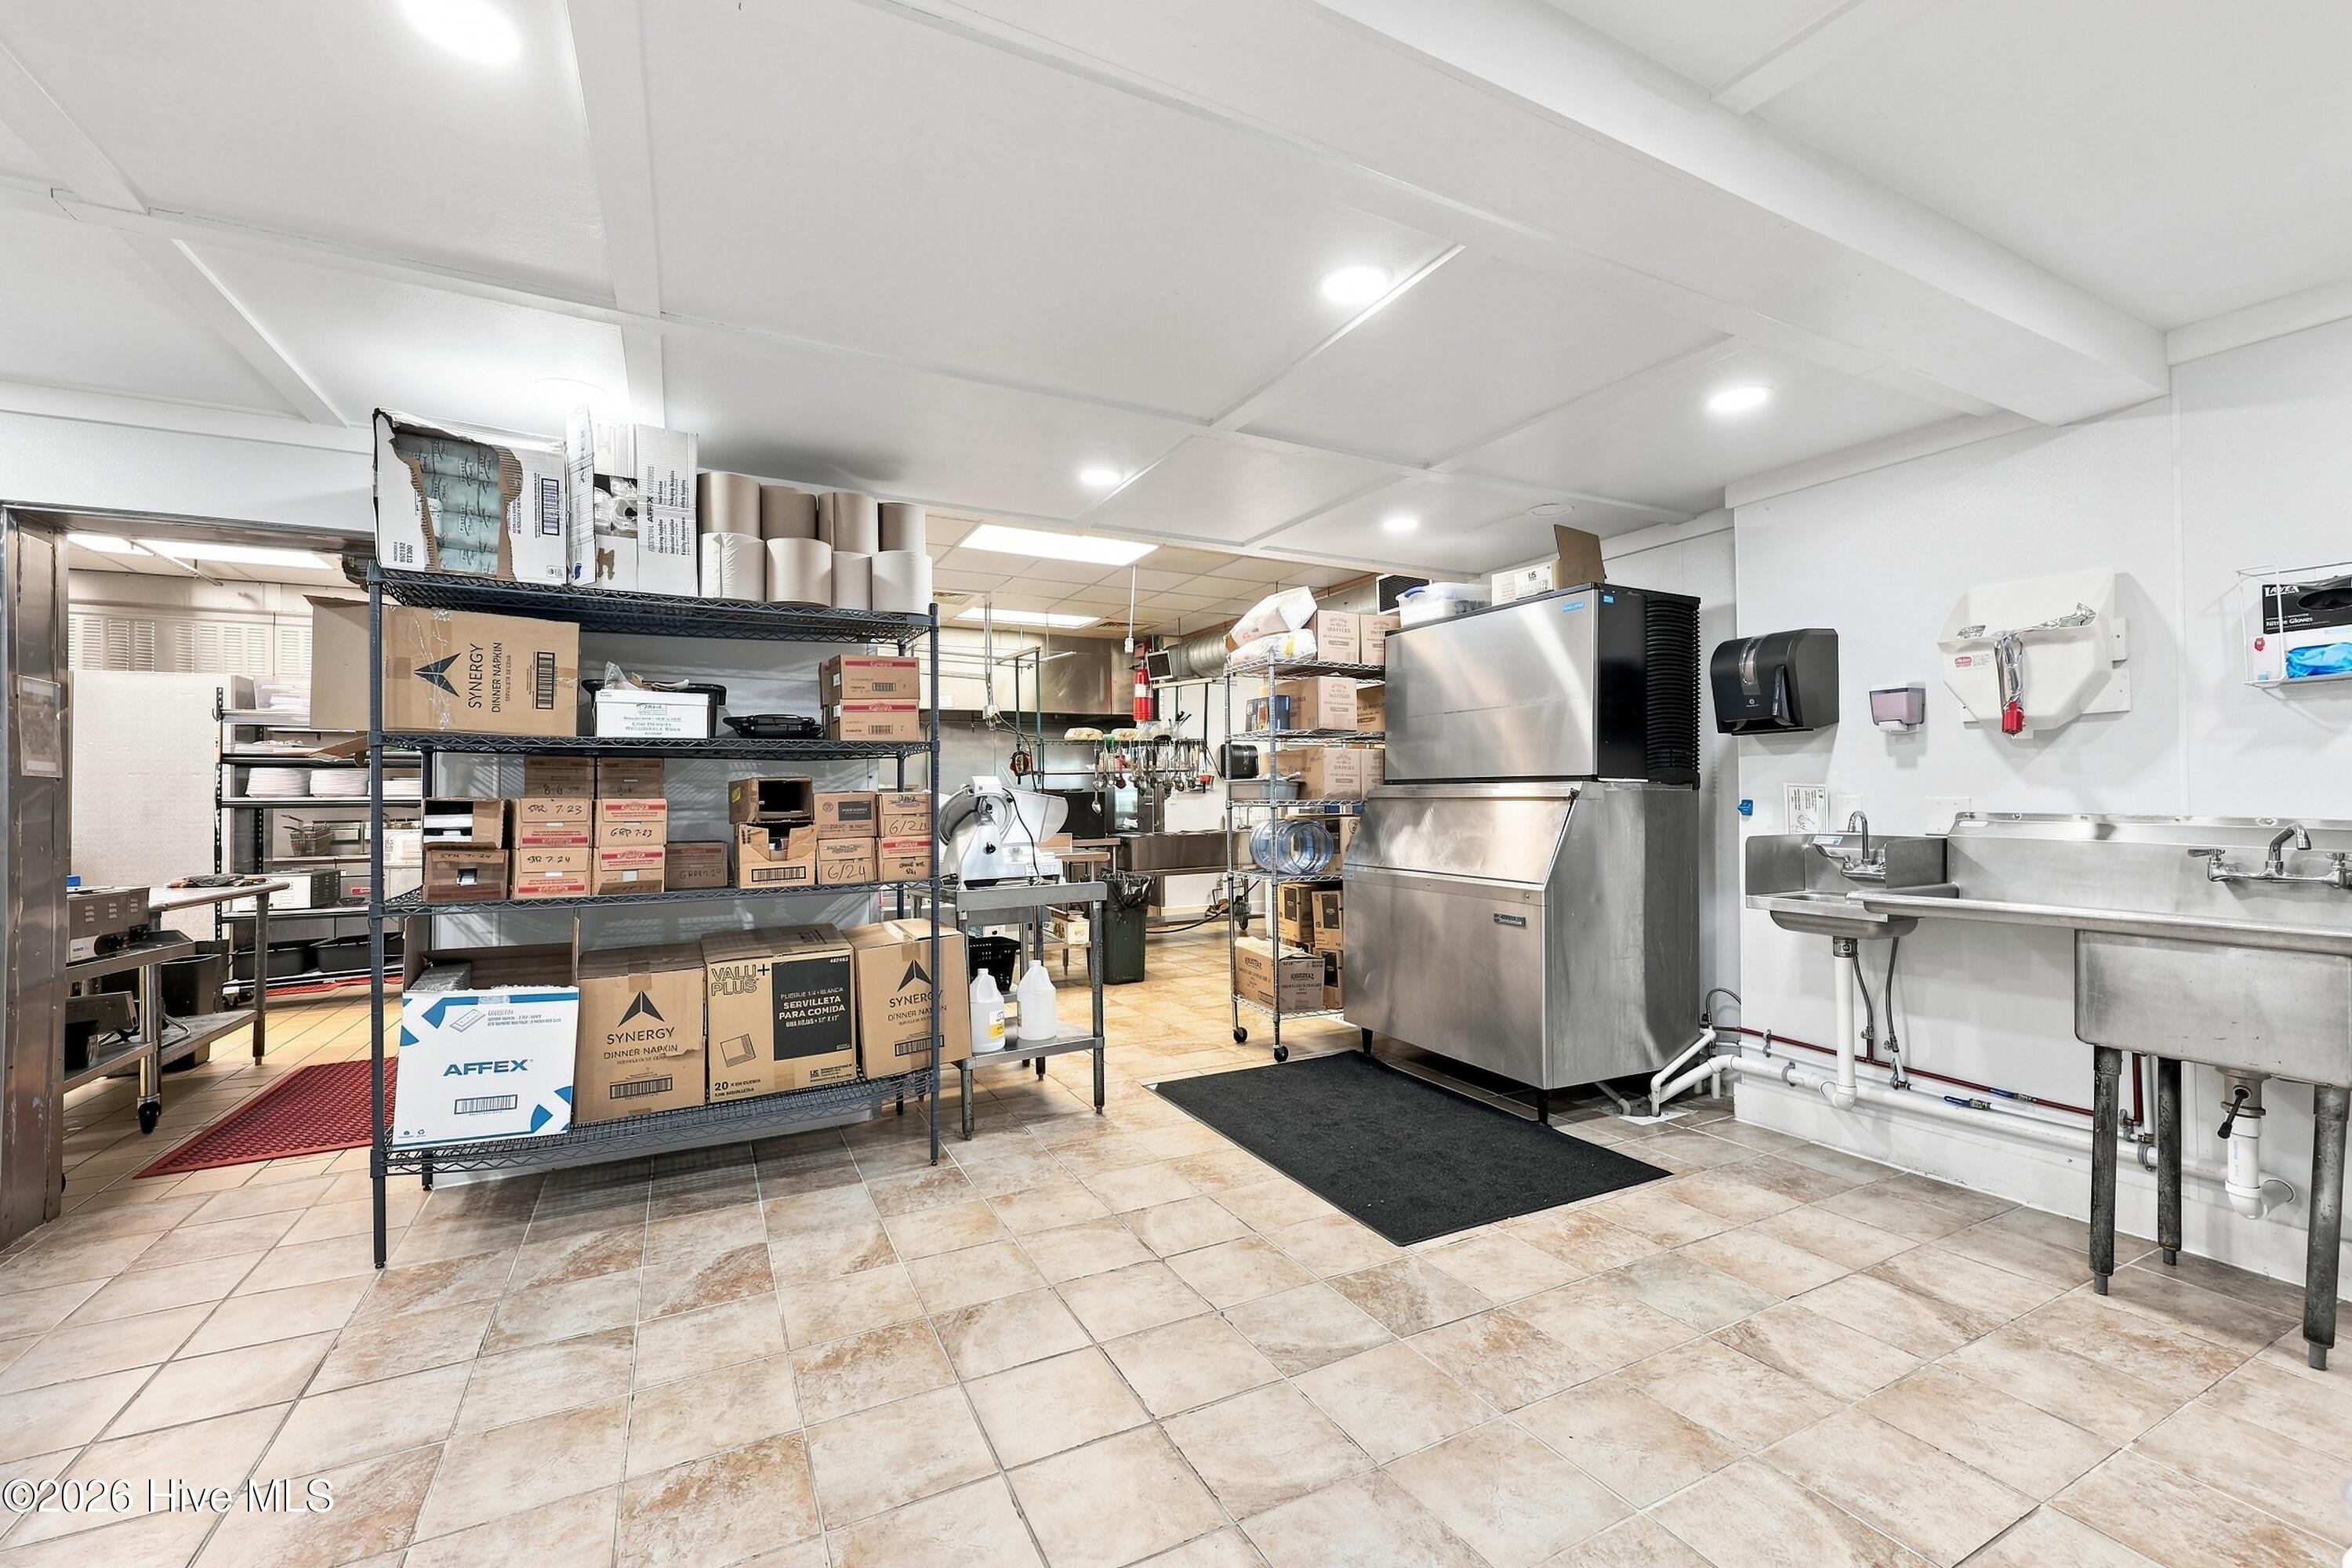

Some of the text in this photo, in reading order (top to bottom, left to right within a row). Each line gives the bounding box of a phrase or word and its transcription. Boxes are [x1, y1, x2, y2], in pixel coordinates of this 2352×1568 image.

[2264, 586, 2300, 597] LAVEX
[468, 643, 484, 709] SYNERGY
[492, 642, 503, 713] DINNER NAPKIN
[827, 864, 866, 883] 6/24
[711, 979, 757, 996] PLUS
[783, 996, 841, 1010] SERVILLETA
[779, 1004, 845, 1020] PARA COMIDA
[887, 1010, 916, 1022] DINNER
[606, 1027, 675, 1045] SYNERGY
[604, 1044, 678, 1060] DINNER NAPKIN
[442, 1058, 529, 1077] AFFEX
[714, 1081, 728, 1091] 20
